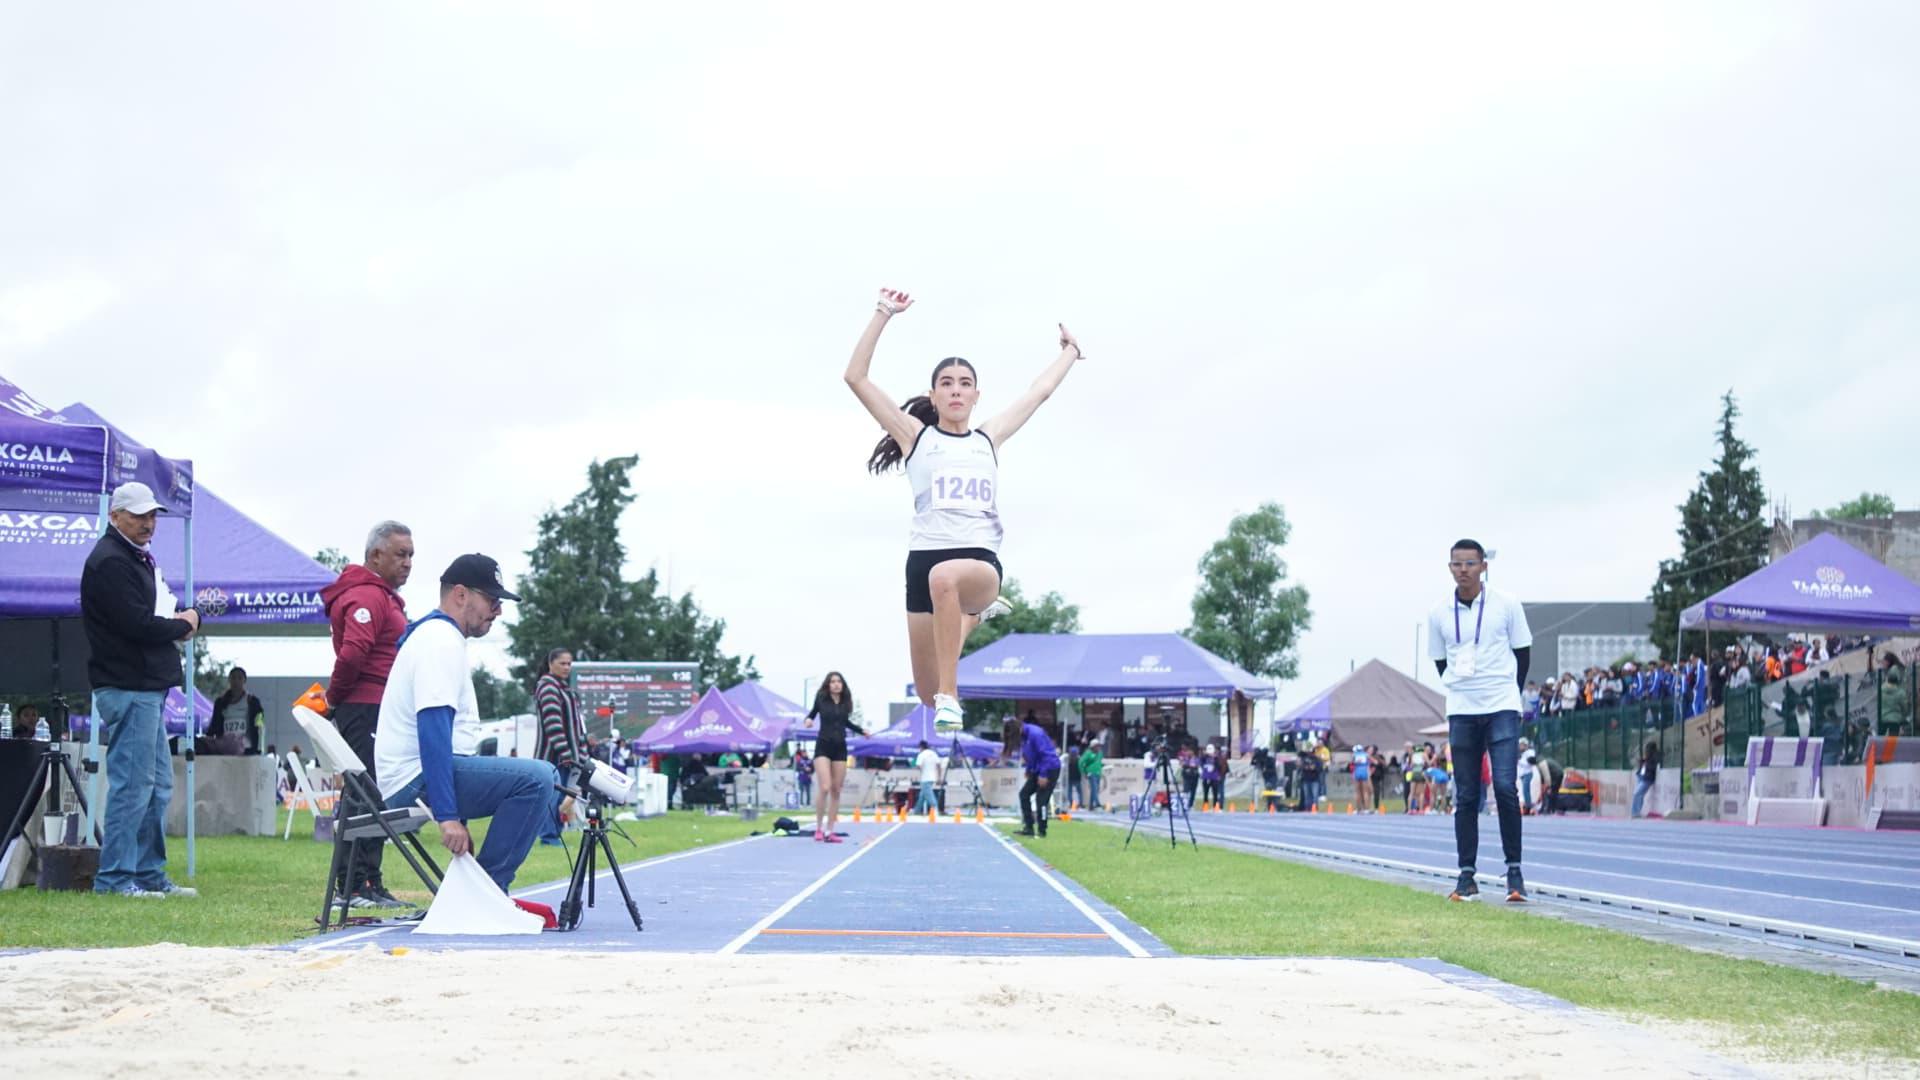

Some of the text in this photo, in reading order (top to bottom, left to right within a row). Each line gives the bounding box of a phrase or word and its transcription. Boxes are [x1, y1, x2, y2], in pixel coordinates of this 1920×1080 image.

[19, 462, 66, 473] HISTORIA
[935, 476, 992, 502] 1246
[1792, 580, 1872, 595] TLAXCALA
[234, 592, 324, 607] TLAXCALA
[225, 721, 245, 731] 1274
